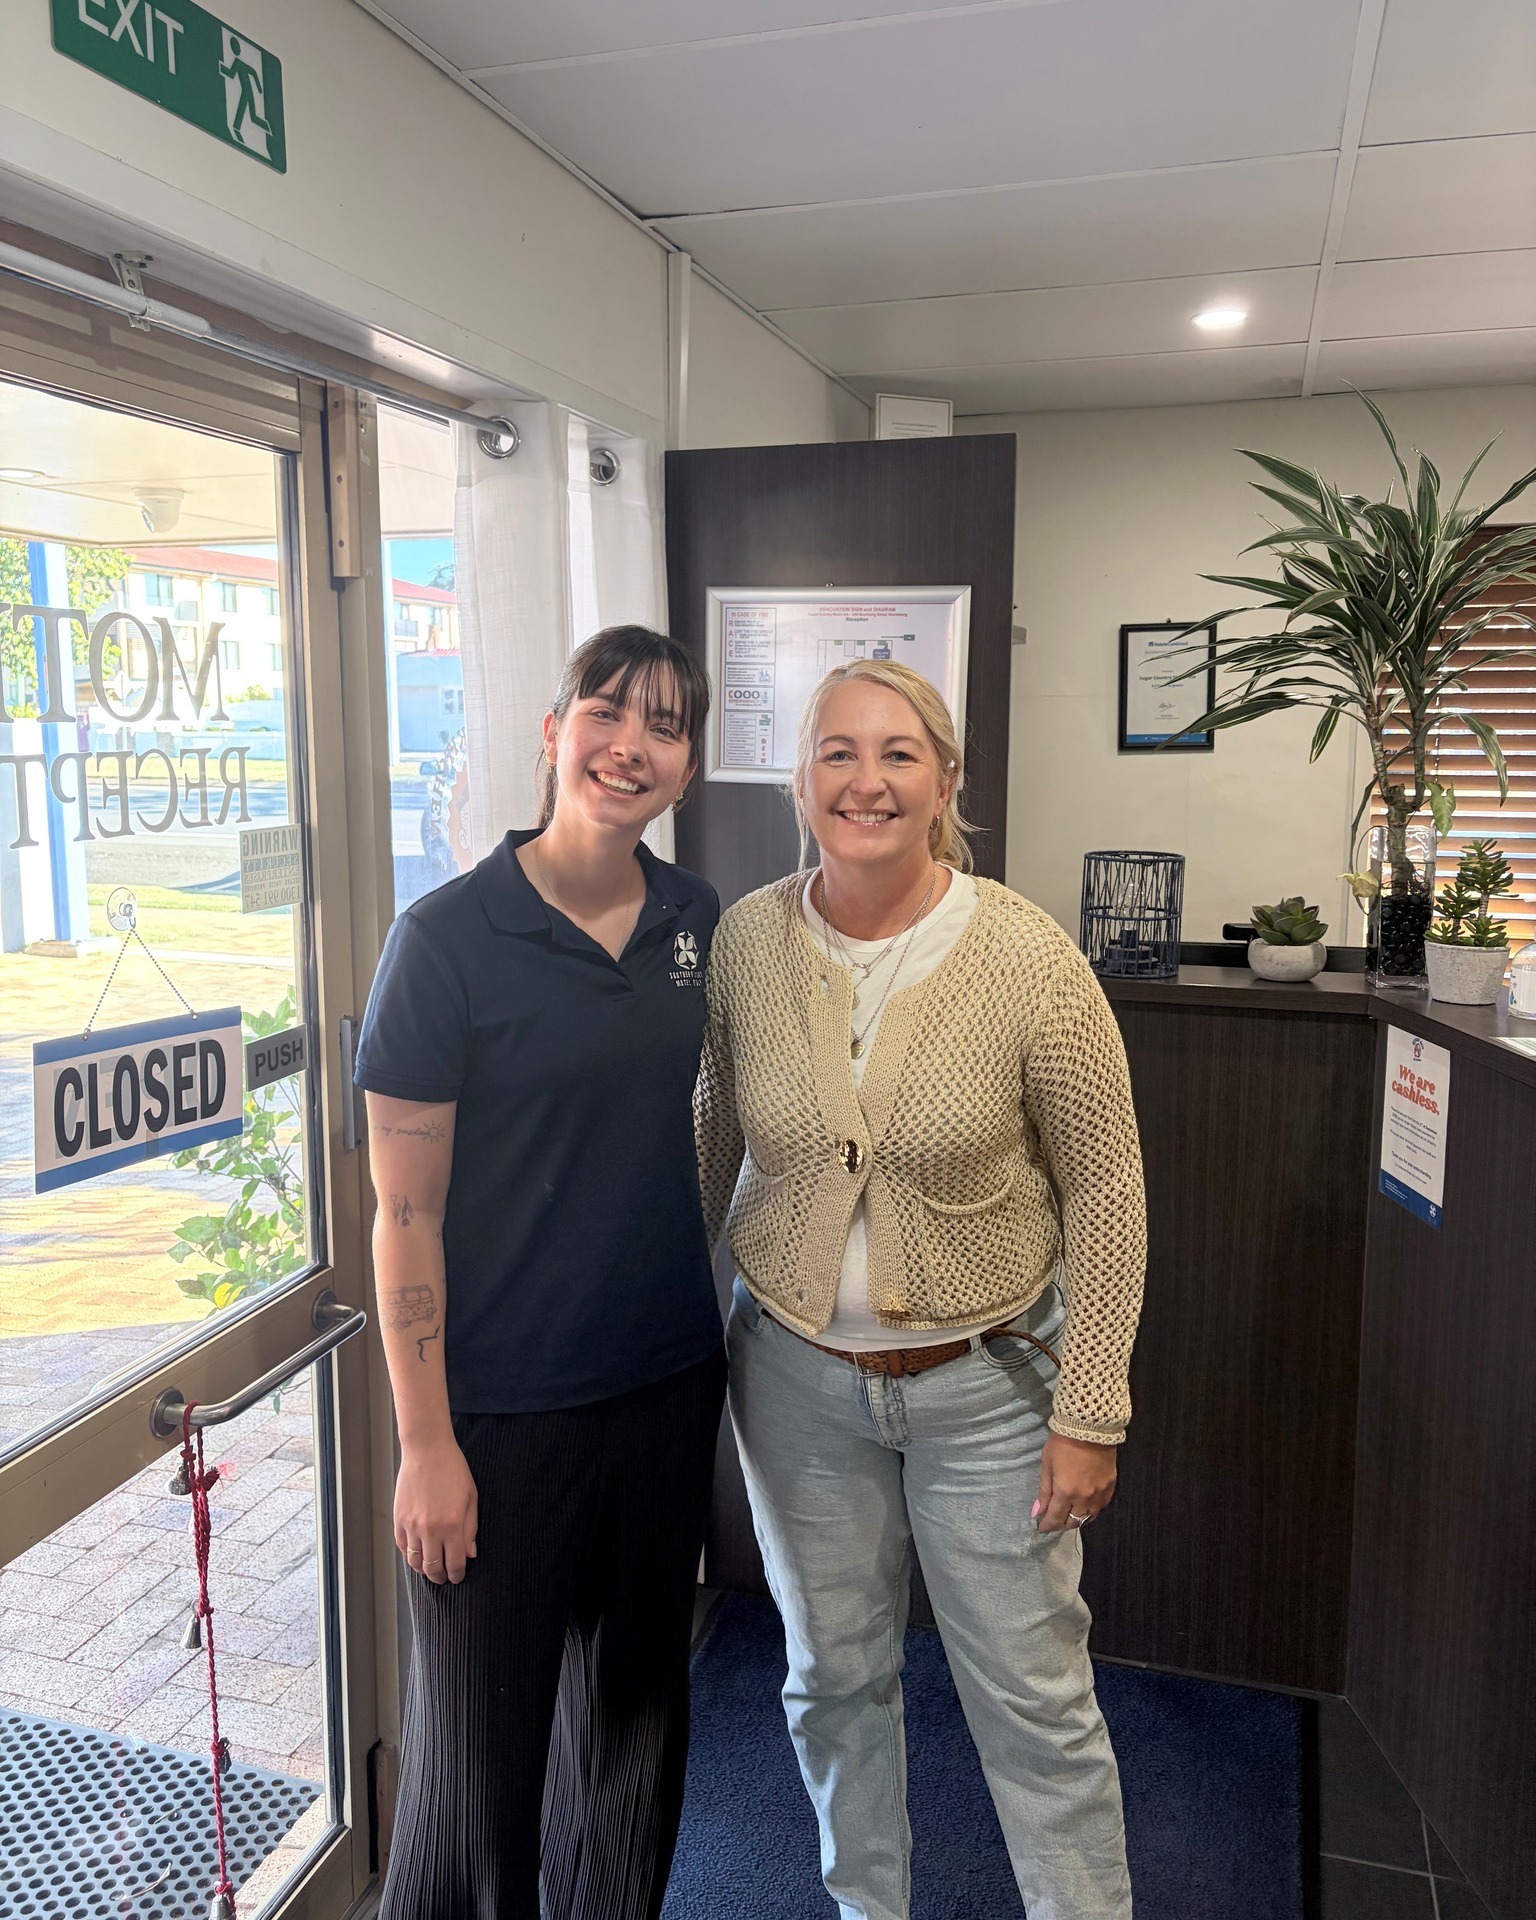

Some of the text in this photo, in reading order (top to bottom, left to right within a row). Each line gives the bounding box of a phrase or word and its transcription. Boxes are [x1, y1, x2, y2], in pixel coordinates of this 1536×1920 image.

[255, 1037, 304, 1077] PUSH
[54, 1038, 227, 1158] CLOSED
[1391, 1080, 1440, 1117] cashless.
[1399, 1063, 1436, 1096] We are
